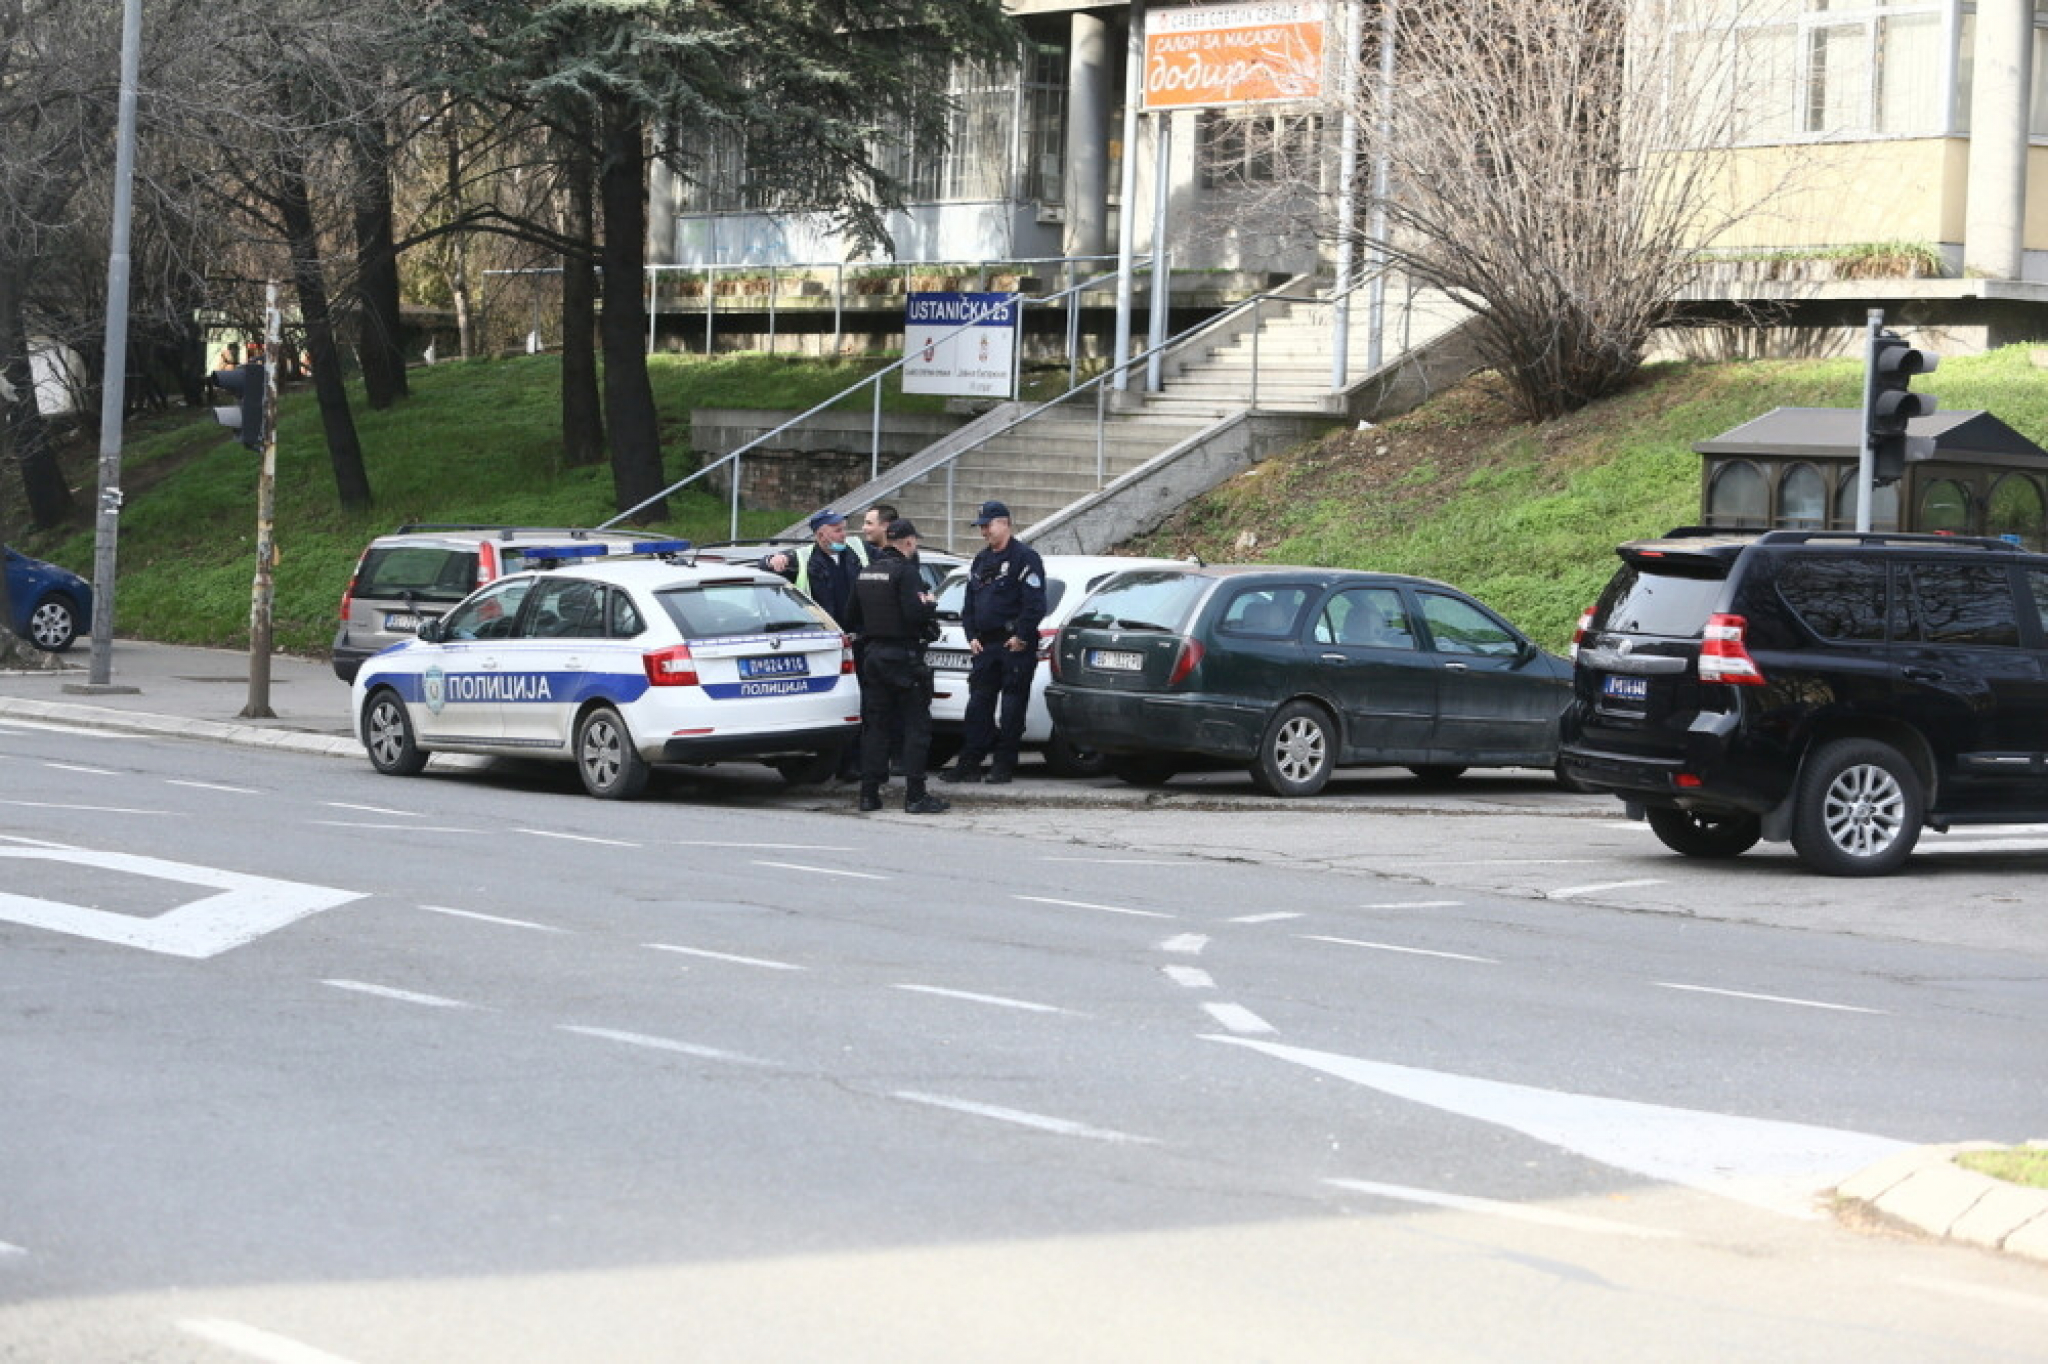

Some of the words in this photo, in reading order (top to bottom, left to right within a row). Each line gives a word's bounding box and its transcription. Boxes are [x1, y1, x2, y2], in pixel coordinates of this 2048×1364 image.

[1155, 34, 1199, 52] САЛОН
[1203, 32, 1221, 50] ЗА
[910, 297, 989, 320] USTANIČKA
[993, 301, 1009, 320] 25
[450, 675, 551, 701] ПОЛИЦИЈА
[741, 680, 808, 695] ПОЛИЦИЈА
